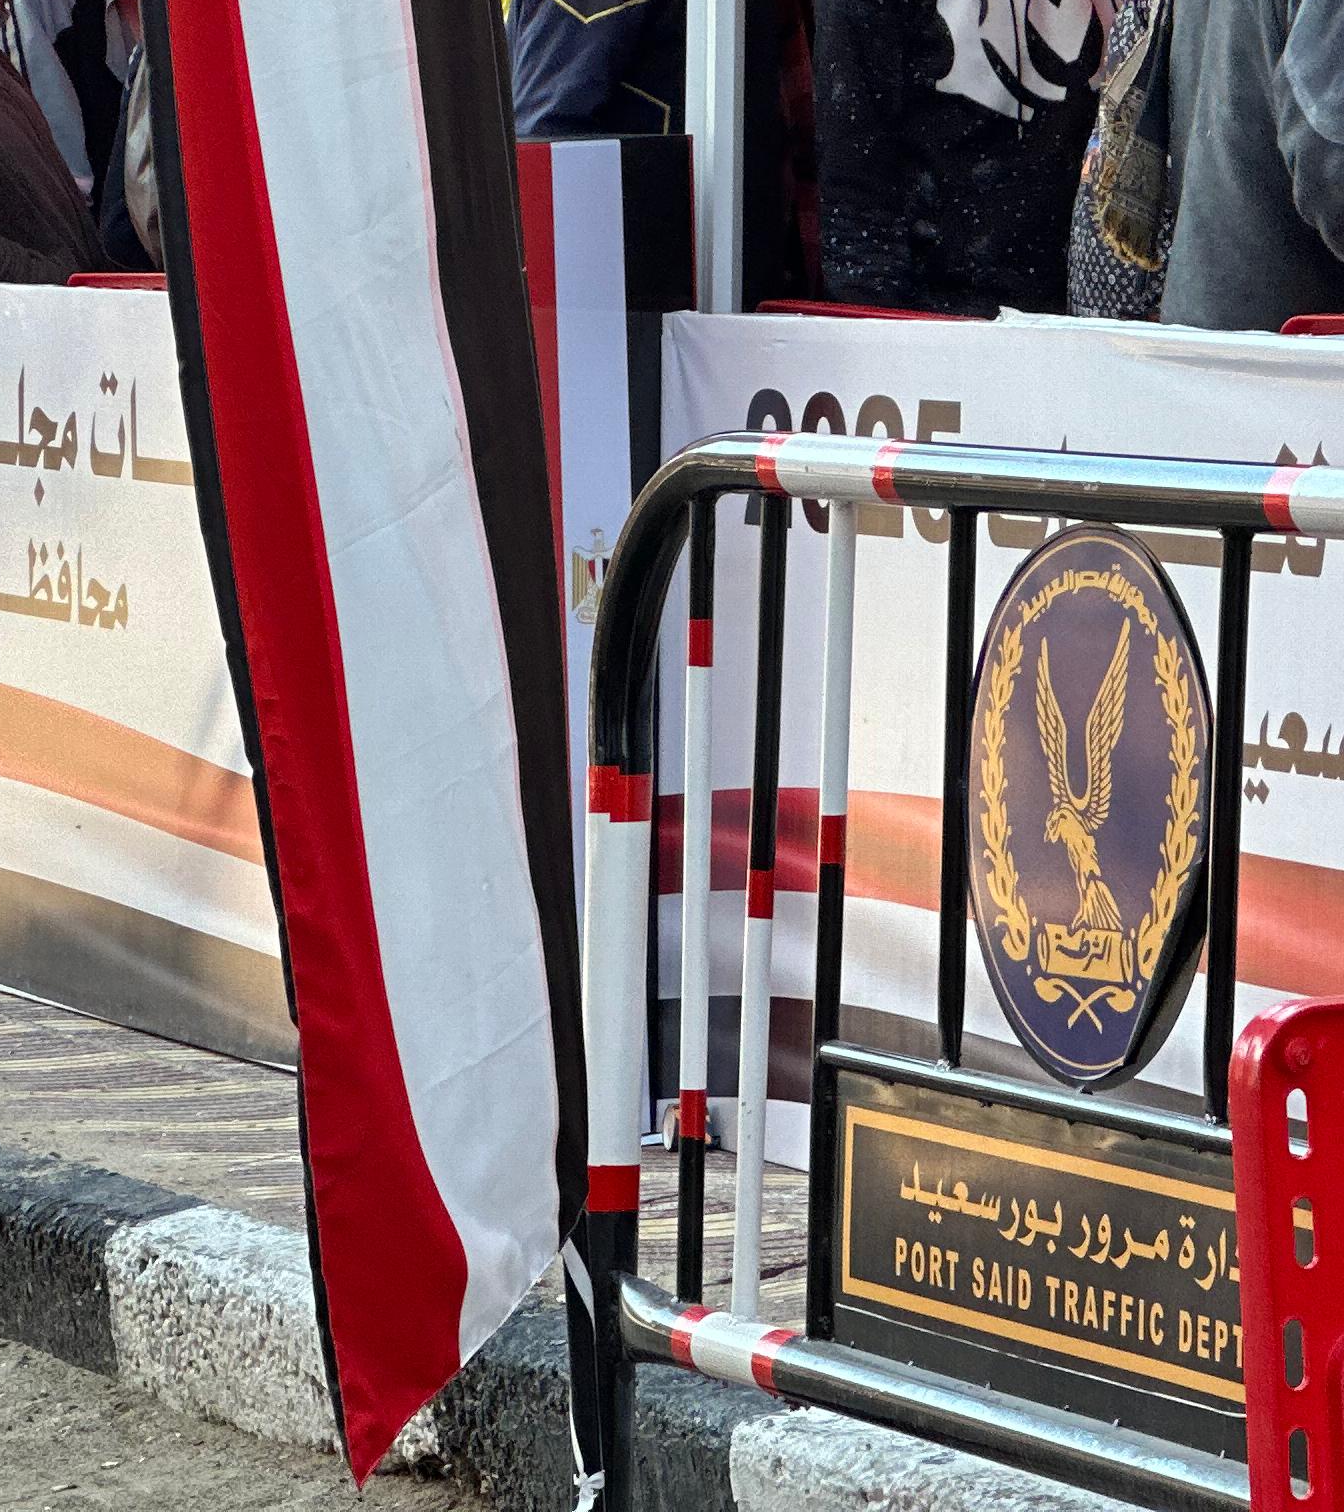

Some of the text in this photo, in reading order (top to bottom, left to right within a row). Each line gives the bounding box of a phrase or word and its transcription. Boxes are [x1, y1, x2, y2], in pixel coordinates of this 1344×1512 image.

[900, 1161, 1063, 1254] بورسعيد
[1068, 1214, 1169, 1270] مرور
[895, 1237, 1244, 1369] PORT SAID TRAFFIC DEPT
